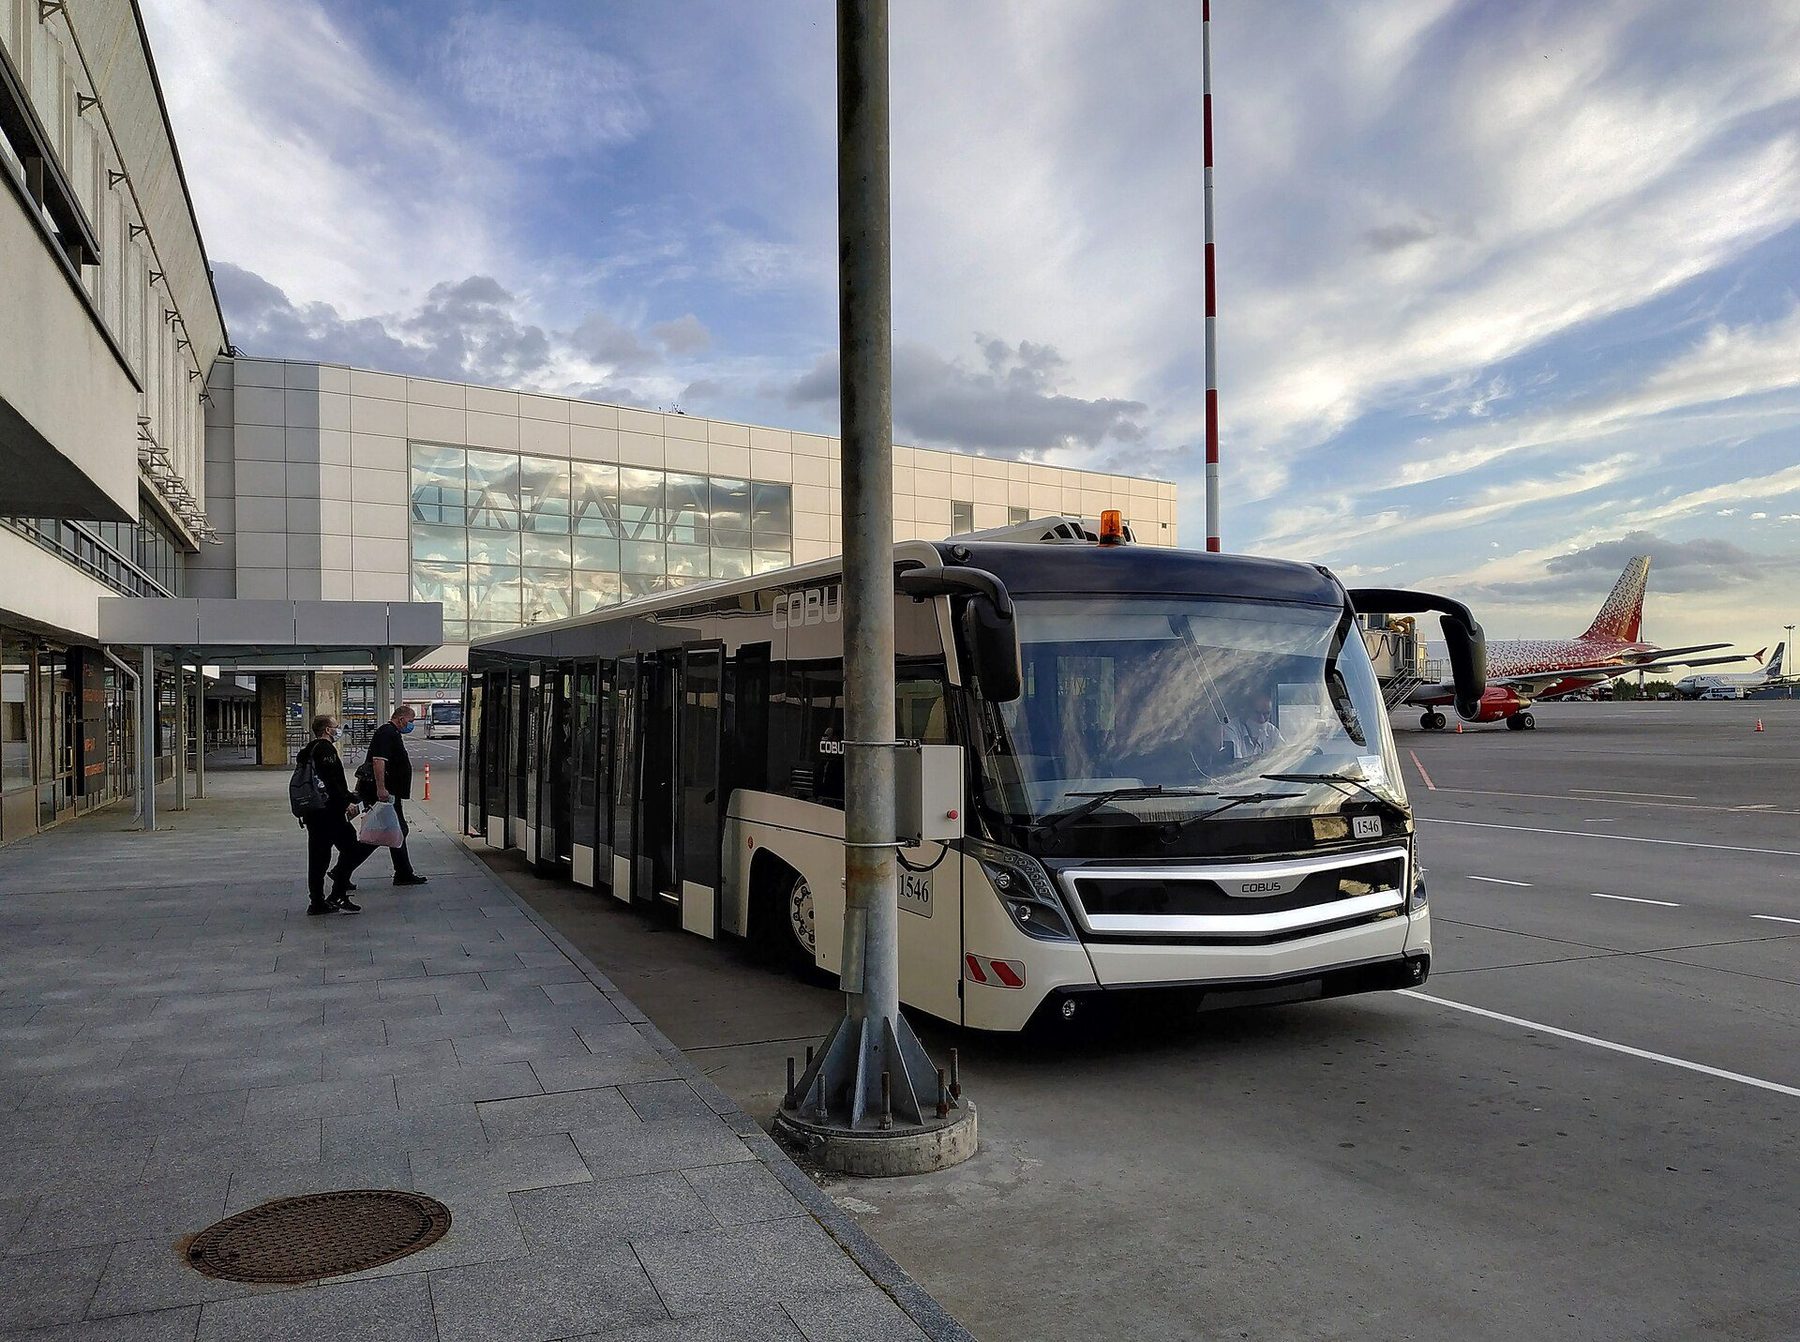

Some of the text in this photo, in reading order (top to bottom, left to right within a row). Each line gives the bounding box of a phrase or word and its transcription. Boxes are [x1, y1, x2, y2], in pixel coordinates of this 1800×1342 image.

[772, 583, 843, 630] COBU
[819, 740, 845, 755] COBU
[1357, 819, 1379, 834] 1546
[899, 873, 929, 903] 1546
[1241, 881, 1281, 893] COBUS
